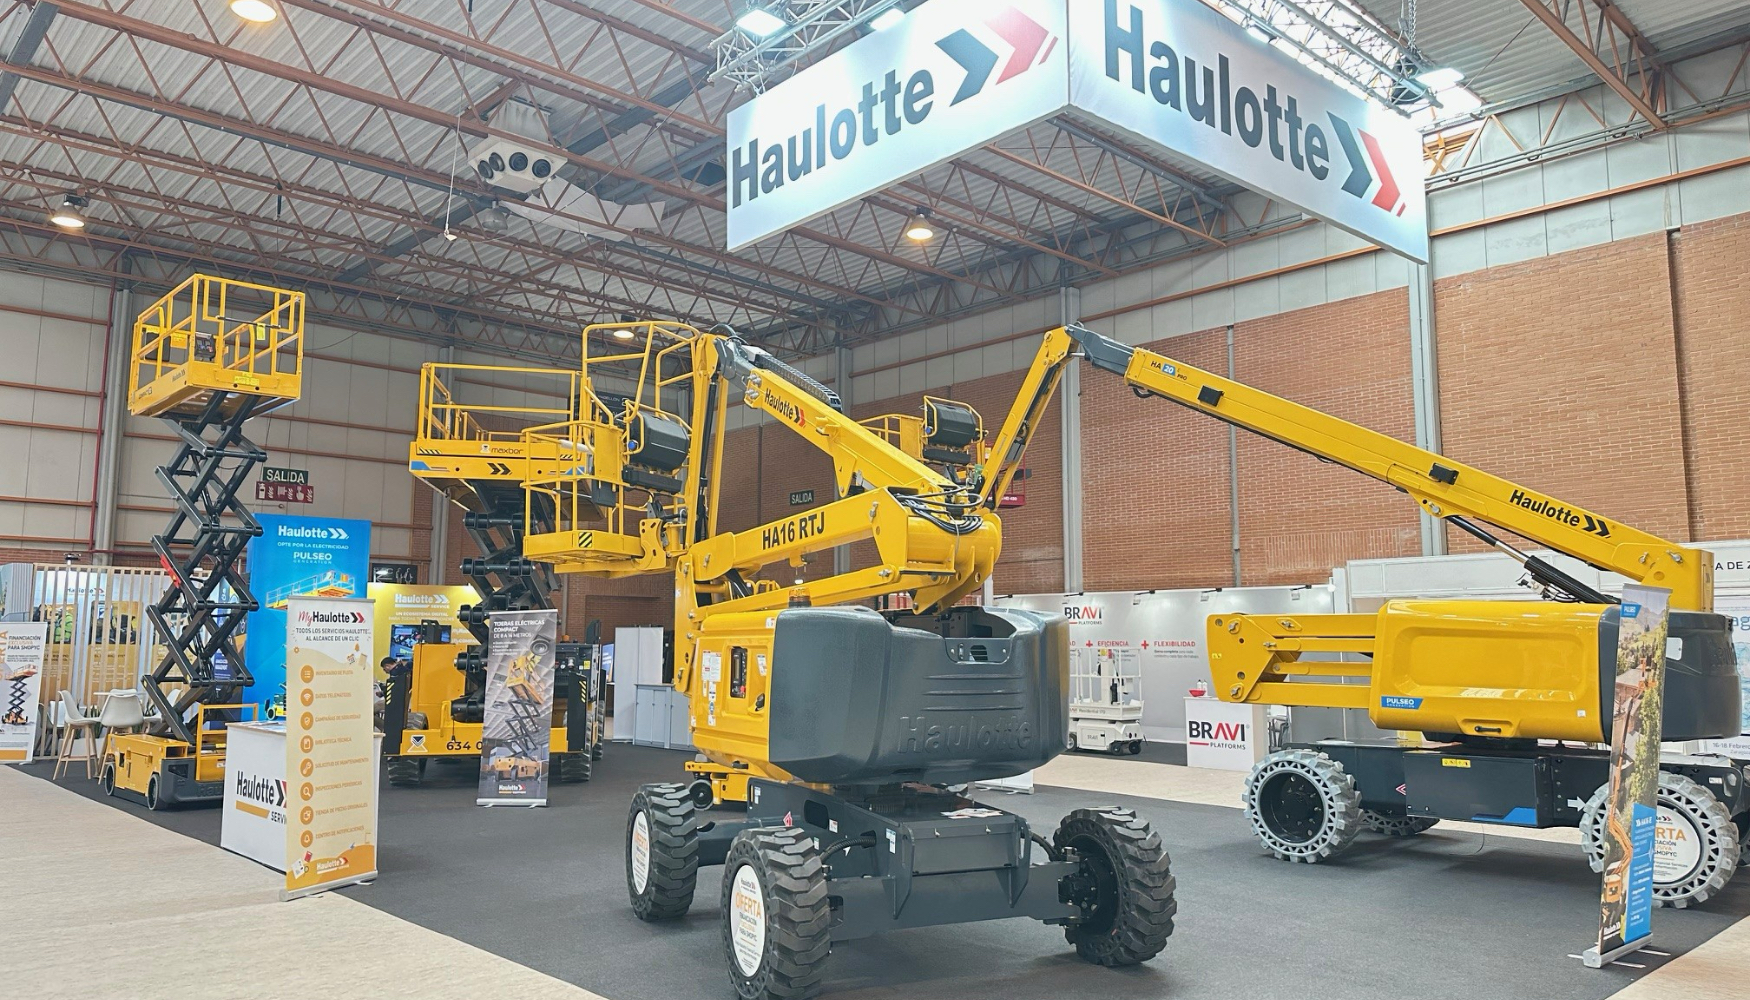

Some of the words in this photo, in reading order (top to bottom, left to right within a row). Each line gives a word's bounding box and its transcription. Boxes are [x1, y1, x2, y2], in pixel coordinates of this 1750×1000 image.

[1104, 0, 1330, 181] Haulotte
[732, 69, 934, 209] Haulotte
[1150, 361, 1161, 370] HA
[1163, 365, 1174, 374] 20
[1176, 373, 1188, 381] PRO
[764, 387, 794, 420] Haulotte
[266, 469, 305, 484] SALIDA
[791, 492, 813, 504] SALIDA
[1509, 489, 1580, 527] Haulotte
[277, 525, 328, 539] Haulotte
[762, 520, 795, 550] HA16
[799, 511, 825, 540] RTJ
[293, 551, 333, 561] PULSEO
[1727, 561, 1744, 570] DE
[394, 593, 434, 604] Haulotte
[1064, 606, 1102, 620] BRAVI
[1097, 640, 1129, 648] EFICIENCIA
[1386, 697, 1415, 705] PULSEO
[897, 716, 1032, 754] Haulotte
[1188, 720, 1246, 742] BRAVI
[446, 741, 472, 751] 634
[1210, 742, 1246, 750] PLATFORMS
[236, 770, 275, 805] Haulotte
[1655, 826, 1687, 841] RTA
[735, 892, 762, 919] OFERTA
